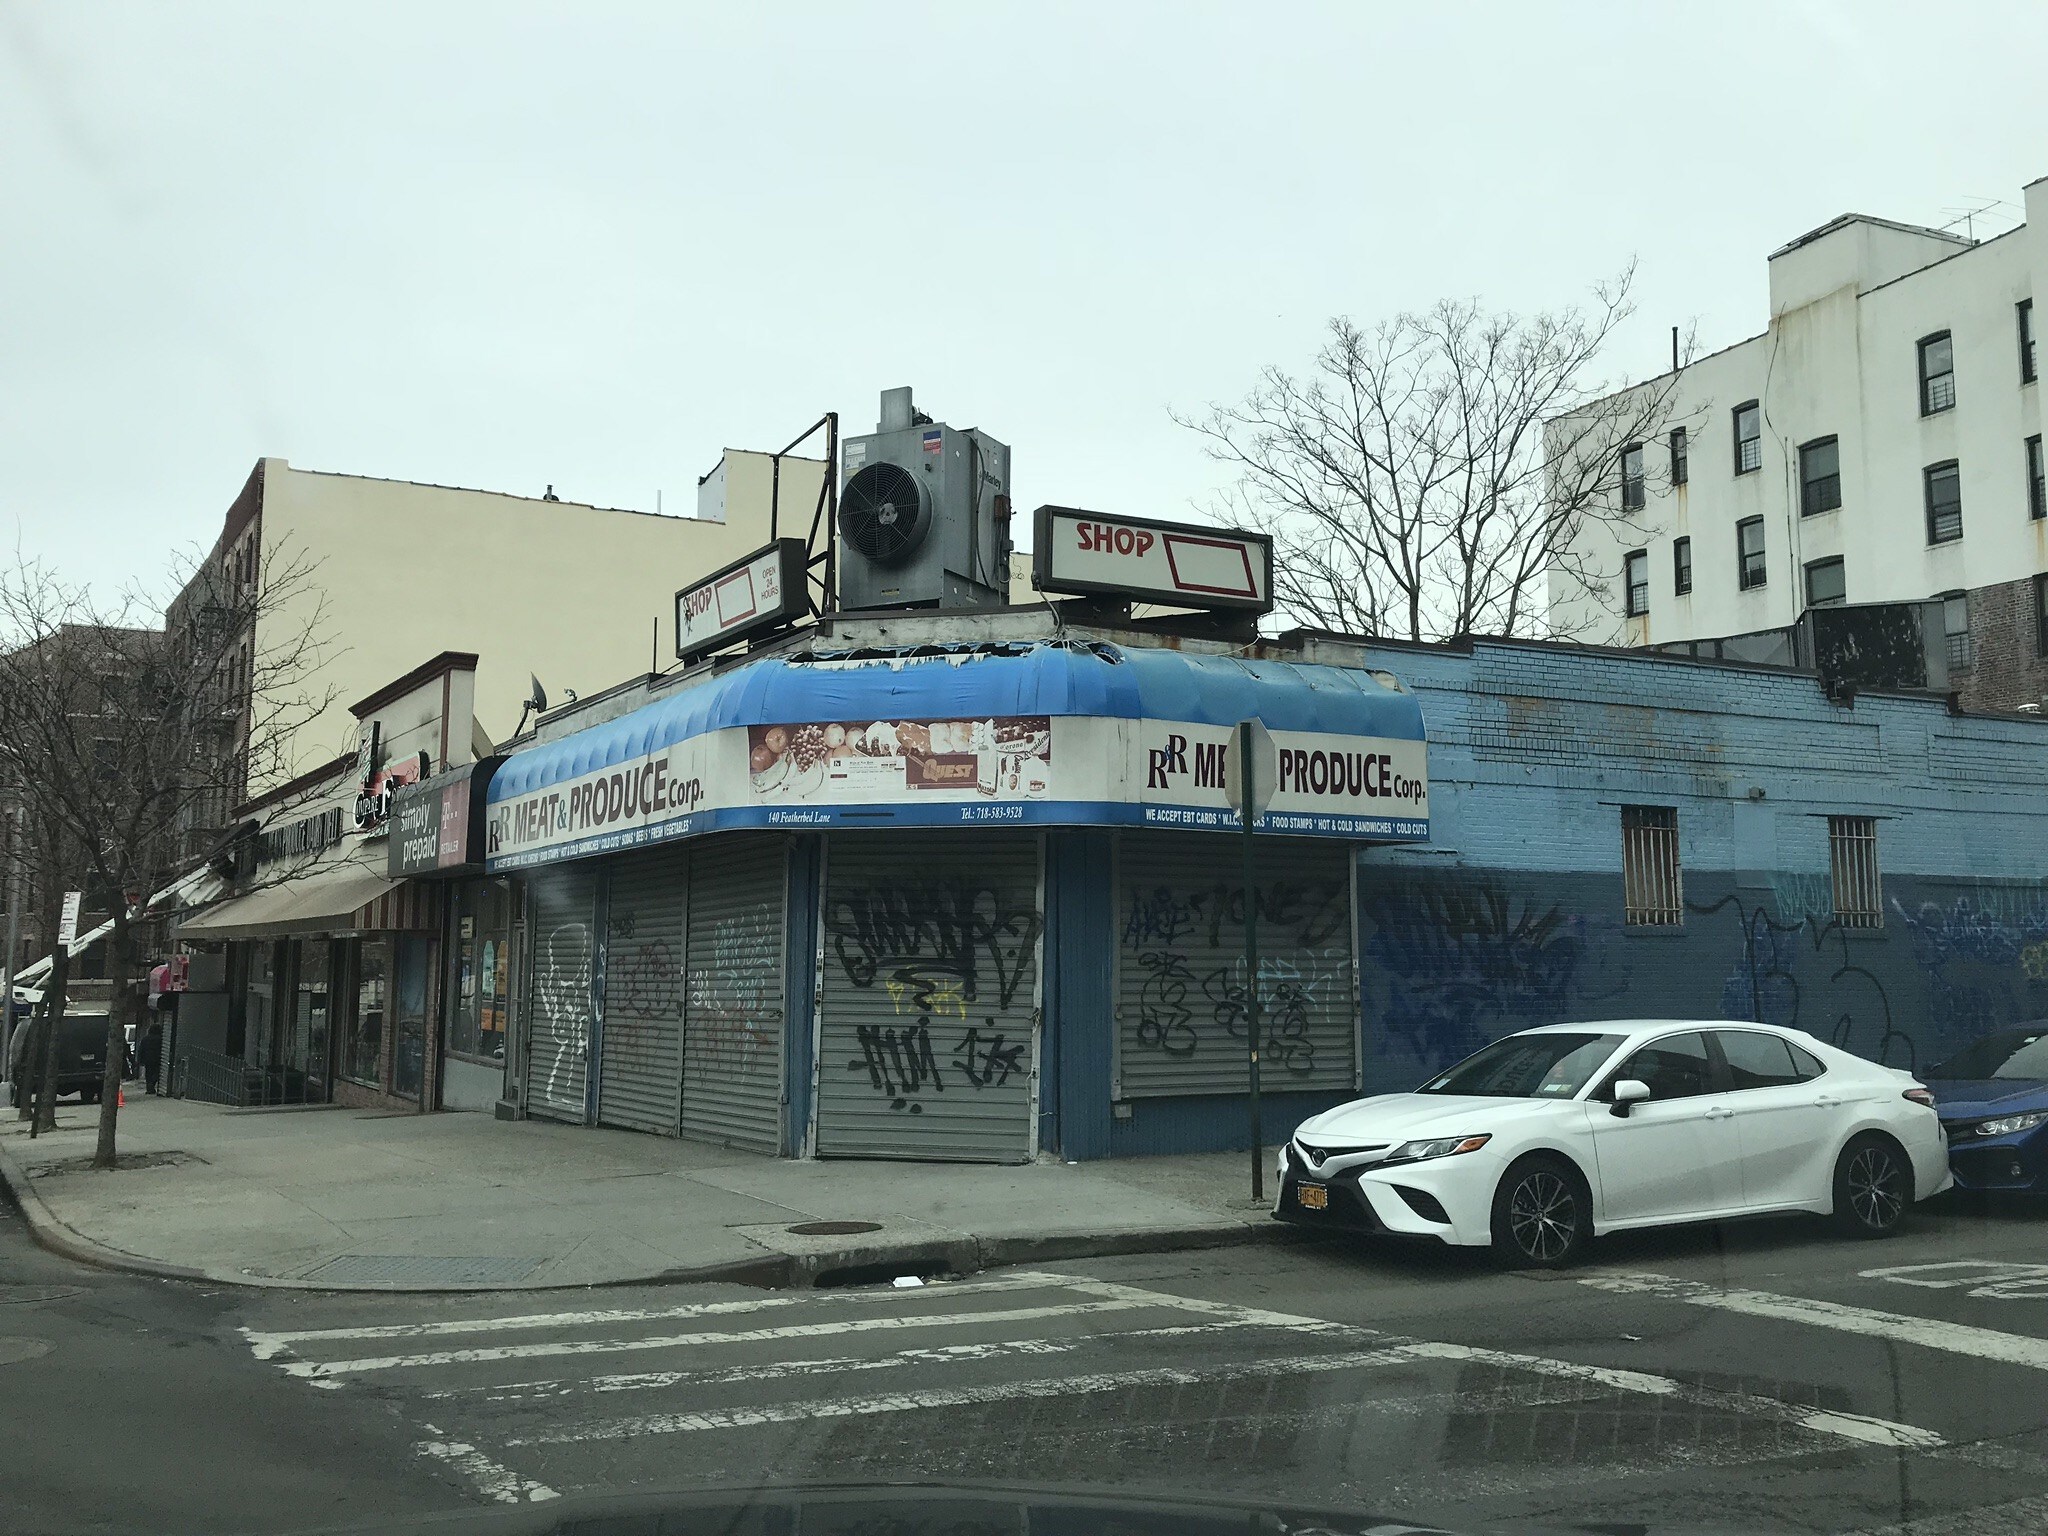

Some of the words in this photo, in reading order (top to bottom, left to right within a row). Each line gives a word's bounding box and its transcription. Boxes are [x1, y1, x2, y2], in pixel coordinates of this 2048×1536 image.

[1076, 522, 1154, 557] SHOP
[762, 565, 776, 579] OPEN
[766, 578, 773, 588] 24
[684, 586, 712, 618] SHOP
[761, 586, 779, 600] HOURS
[1279, 749, 1392, 797] PRODUCE
[1393, 774, 1426, 805] Corp.
[513, 792, 560, 845] MEAT
[568, 757, 668, 832] PRODUCE
[669, 777, 704, 811] Corp.
[976, 806, 1023, 819] 718-583-9528
[401, 797, 430, 835] simply
[650, 825, 664, 840] FRESH
[664, 819, 689, 837] VEGETABLES
[768, 811, 779, 823] 140
[780, 811, 814, 823] Featherbed
[814, 811, 831, 823] Lane
[1145, 808, 1156, 821] WE
[1157, 809, 1181, 822] ACCEPT
[1183, 811, 1196, 823] EBT
[1196, 812, 1217, 825] CARDS
[1272, 816, 1288, 828] FOOD
[1289, 817, 1313, 830] STAMPS
[1318, 818, 1331, 831] HOT
[1337, 820, 1353, 832] COLD
[1355, 821, 1392, 834] SANDWICHES
[1396, 823, 1411, 834] COLD
[1412, 823, 1427, 835] CUTS
[402, 827, 437, 870] prepaid
